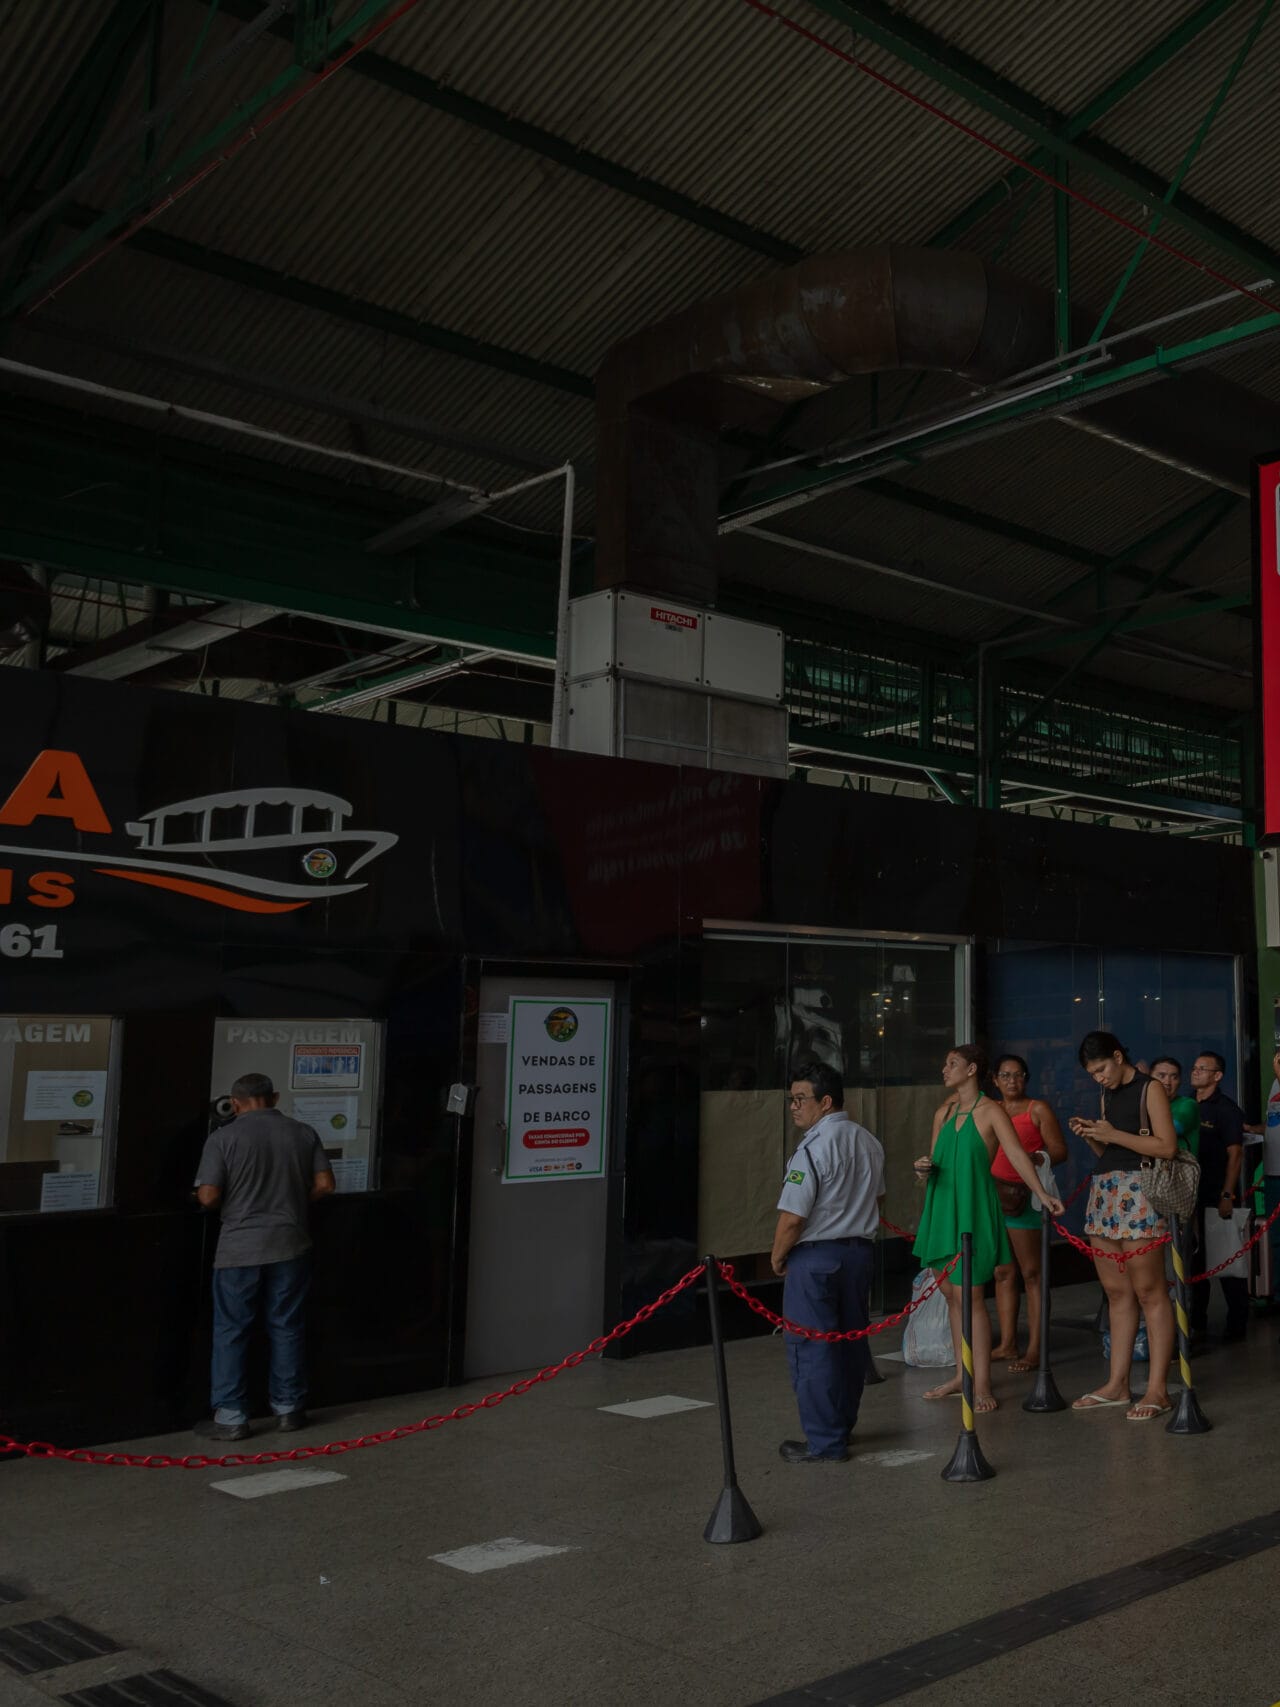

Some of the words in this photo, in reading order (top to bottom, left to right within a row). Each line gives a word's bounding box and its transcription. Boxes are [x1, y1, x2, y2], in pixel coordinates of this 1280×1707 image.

[656, 611, 693, 627] HITACHI
[0, 749, 112, 834] A
[0, 923, 64, 959] 61
[226, 1026, 361, 1044] PASSAGEM
[522, 1056, 575, 1067] VENDAS
[580, 1055, 596, 1066] DE
[518, 1083, 597, 1095] PASSAGENS
[524, 1112, 540, 1123] DE
[545, 1110, 590, 1122] BARCO
